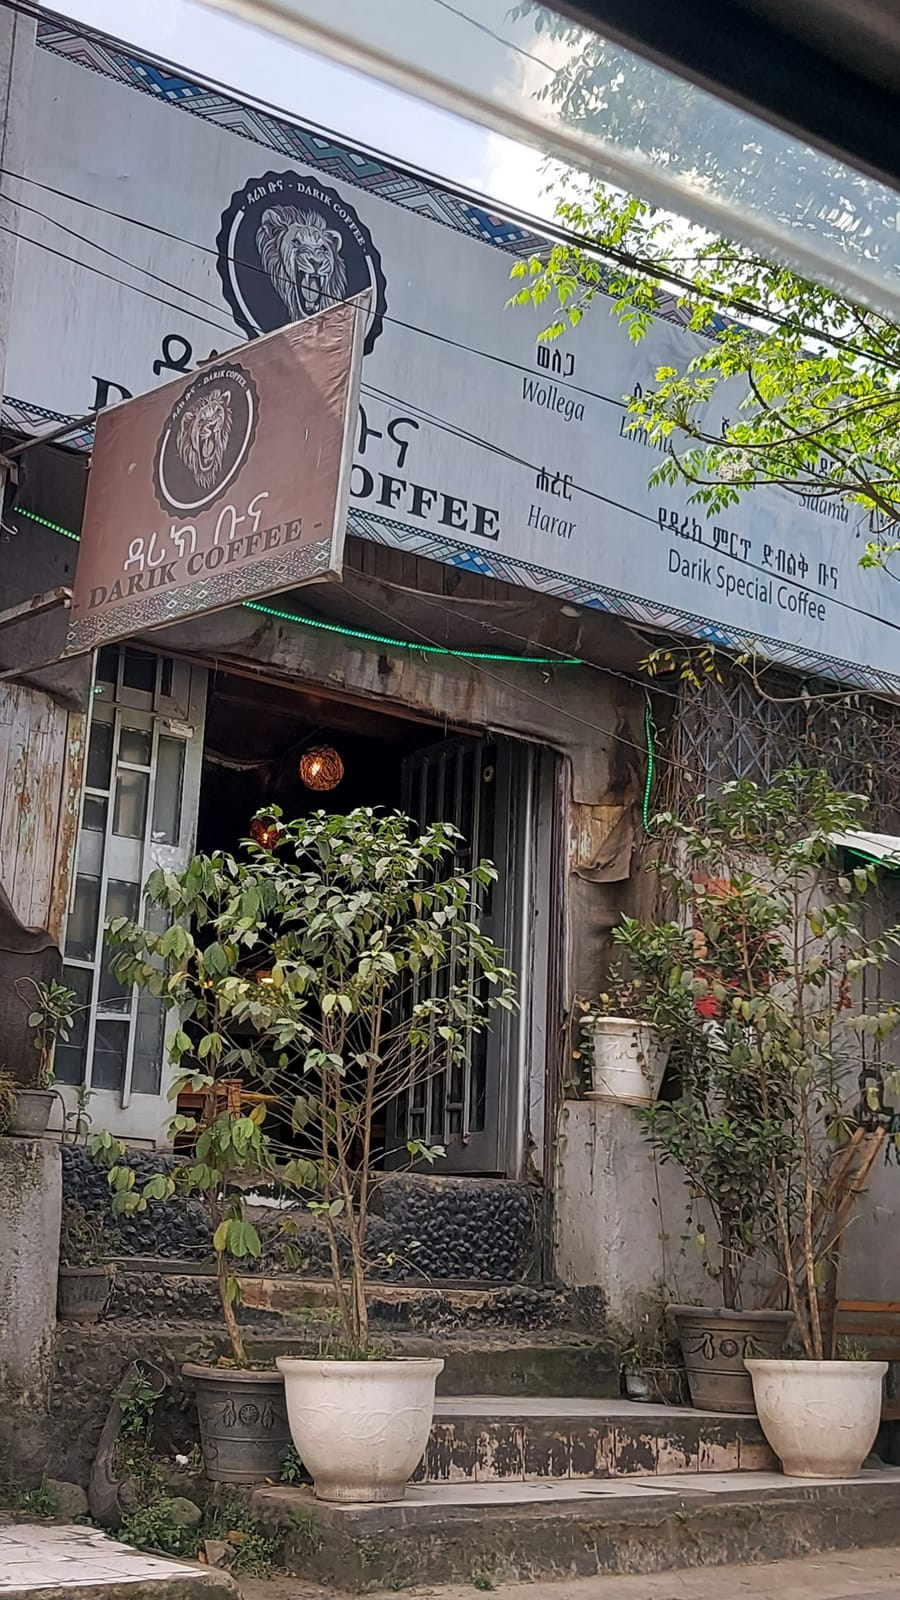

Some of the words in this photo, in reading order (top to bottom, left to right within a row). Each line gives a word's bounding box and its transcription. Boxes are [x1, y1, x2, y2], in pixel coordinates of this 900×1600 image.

[297, 182, 332, 206] DARIK
[333, 203, 366, 246] COFFEE
[203, 370, 226, 385] DARIK
[225, 370, 247, 389] COFFEE
[536, 345, 575, 377] ወለጋ
[522, 377, 585, 422] Wollega
[214, 491, 271, 545] ቡና
[350, 464, 500, 542] OFFEE
[527, 504, 577, 539] Harar
[799, 486, 849, 523] Sidama
[88, 560, 177, 610] DARIK
[187, 517, 303, 576] COFFEE
[668, 548, 711, 585] Darik
[716, 565, 772, 605] Special
[777, 586, 826, 622] Coffee
[818, 563, 838, 590] ቡና
